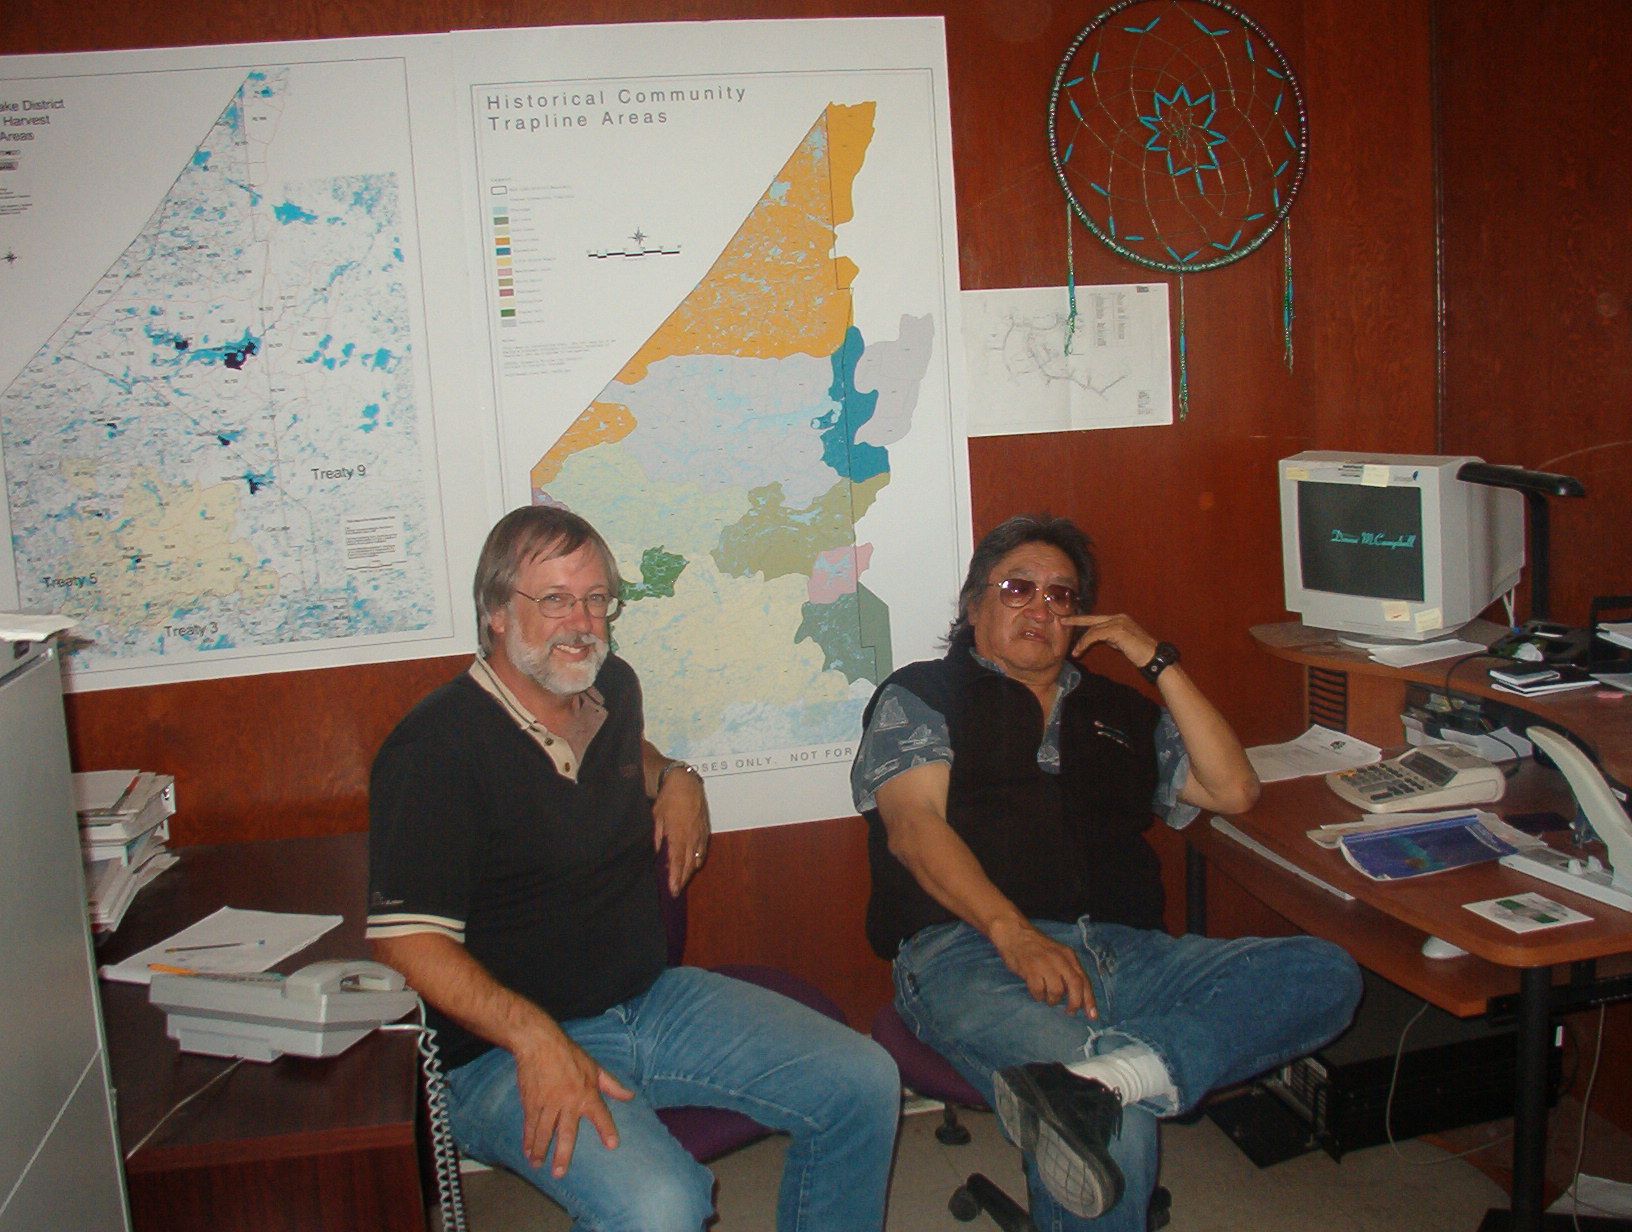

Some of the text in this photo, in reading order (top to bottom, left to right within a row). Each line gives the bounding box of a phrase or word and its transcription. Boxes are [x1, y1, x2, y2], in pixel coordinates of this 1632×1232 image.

[22, 99, 65, 111] District
[487, 86, 746, 110] Historical Community
[3, 115, 50, 126] Harvest
[488, 110, 667, 132] Trapline Areas
[310, 464, 366, 480] Treaty 9
[42, 572, 98, 588] Treaty 5
[163, 621, 219, 637] Treaty 3
[790, 752, 818, 762] NOT
[825, 747, 853, 758] FOR
